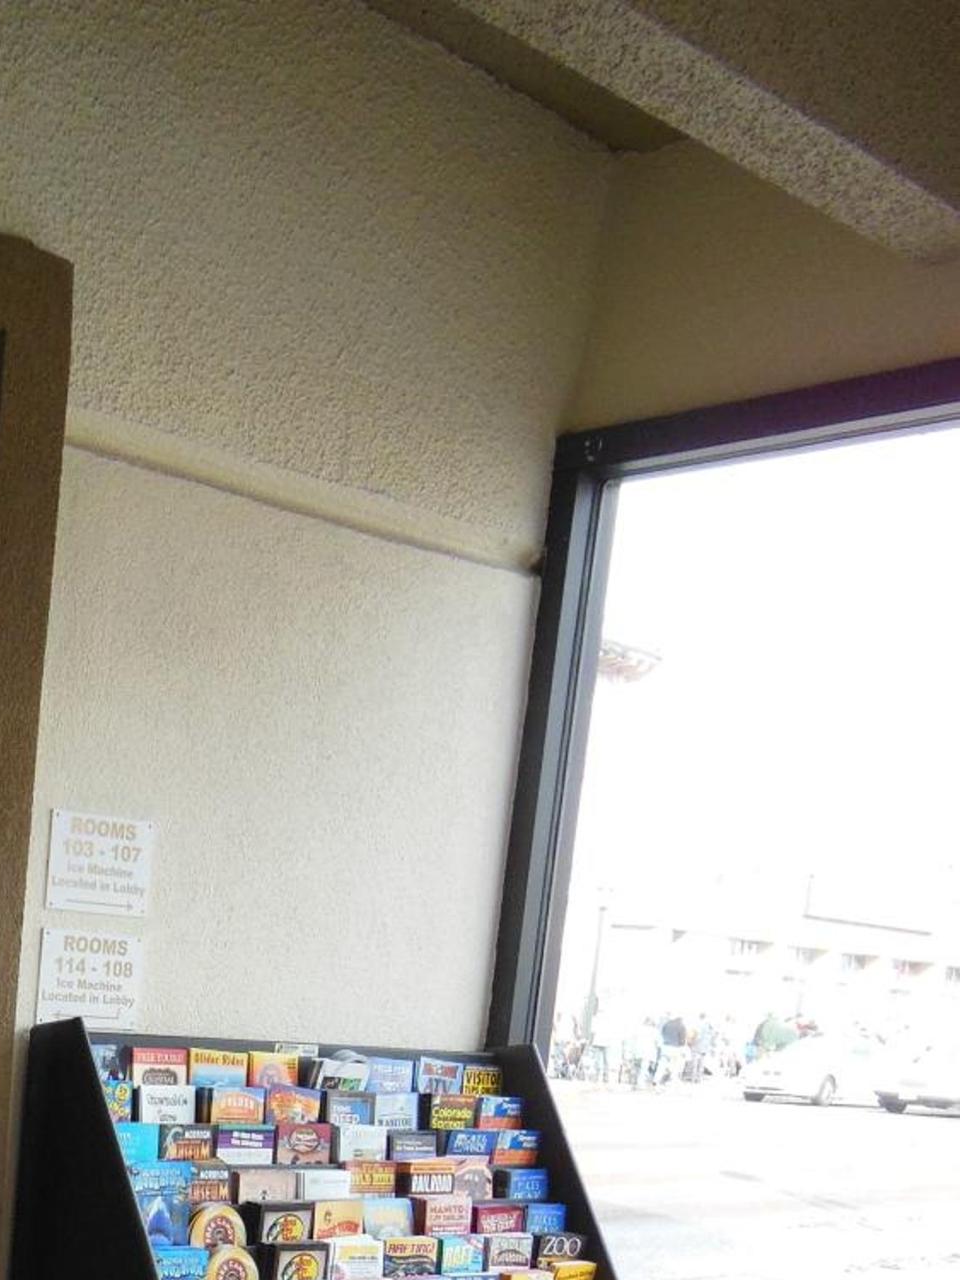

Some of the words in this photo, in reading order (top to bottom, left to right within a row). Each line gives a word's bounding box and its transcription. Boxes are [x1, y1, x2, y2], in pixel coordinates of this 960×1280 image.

[70, 817, 137, 841] ROOMS
[62, 840, 95, 858] 103
[111, 845, 142, 863] 107
[67, 861, 85, 873] Ice
[87, 864, 134, 879] Machine
[52, 875, 97, 891] Located
[99, 880, 110, 892] in
[113, 882, 145, 899] Lobby
[63, 935, 129, 957] ROOMS
[55, 957, 86, 975] 114
[102, 961, 133, 978] 108
[56, 978, 73, 989] Ice
[76, 979, 123, 993] Machine
[41, 989, 86, 1004] Located
[88, 994, 100, 1005] in
[103, 994, 135, 1009] Lobby
[432, 1106, 473, 1119] Colorado
[544, 1235, 582, 1256] ZOO
